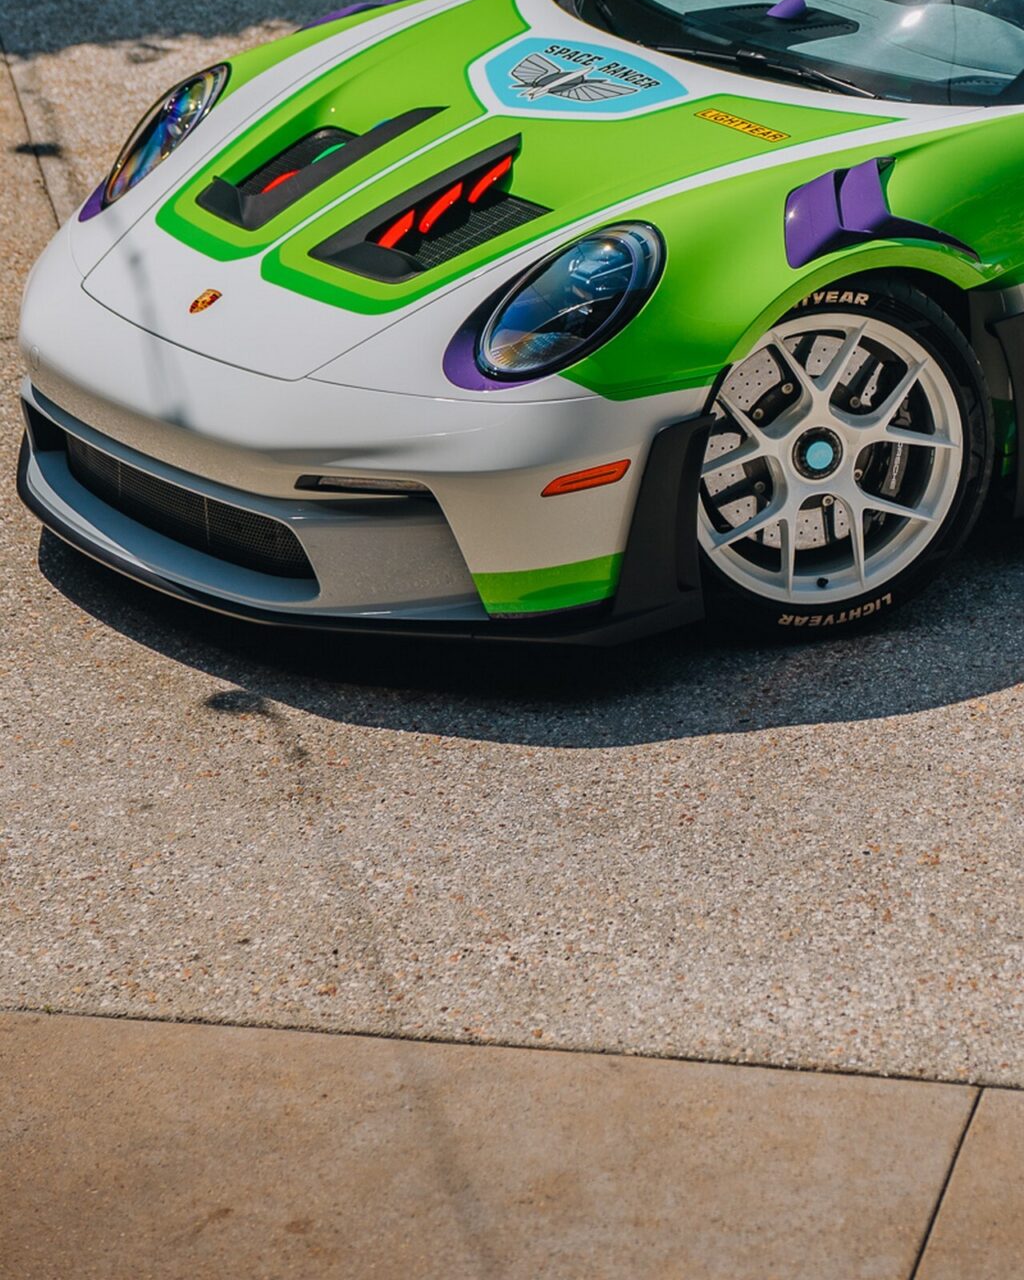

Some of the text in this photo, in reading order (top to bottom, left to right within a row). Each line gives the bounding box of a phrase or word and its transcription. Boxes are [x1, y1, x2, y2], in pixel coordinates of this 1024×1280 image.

[544, 43, 661, 91] SPACE RANGER
[700, 109, 785, 143] LIGHTYEAR
[777, 591, 893, 627] LIGHTYEAR
